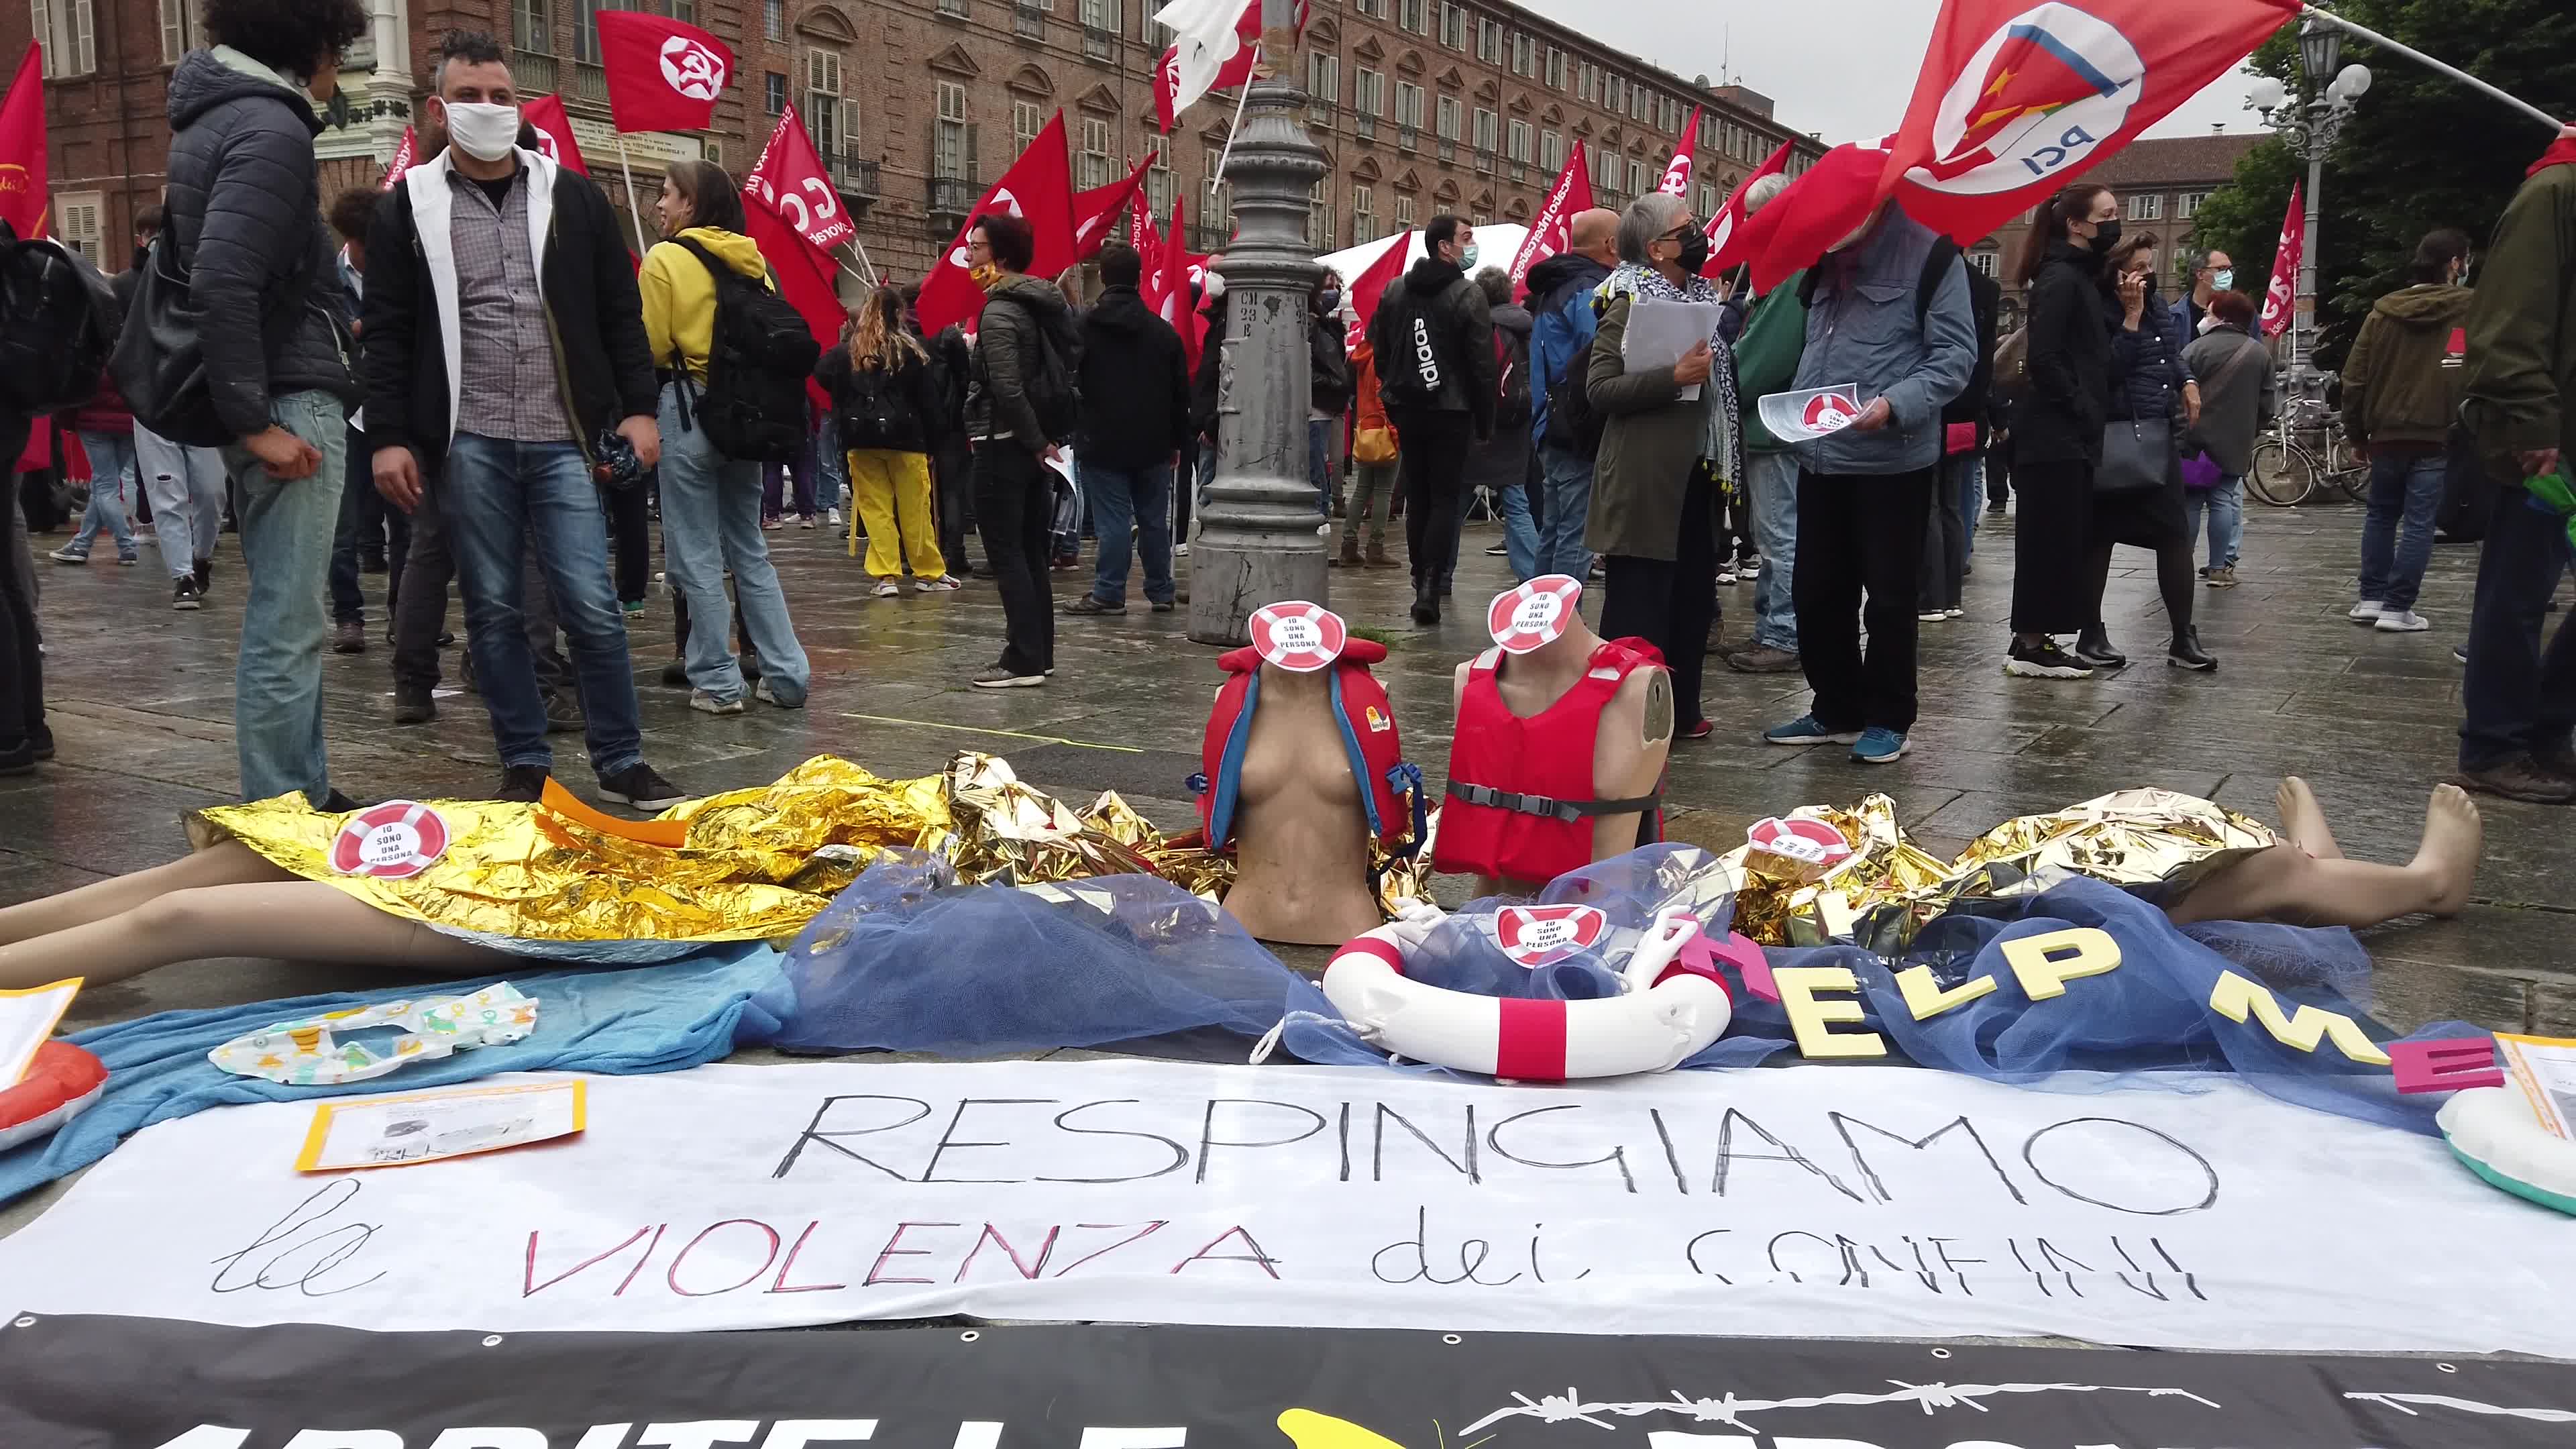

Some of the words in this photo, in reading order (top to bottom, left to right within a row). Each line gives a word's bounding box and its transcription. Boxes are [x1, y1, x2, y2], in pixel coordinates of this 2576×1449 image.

[1240, 307, 1256, 322] 23
[383, 825, 392, 833] IO
[376, 833, 402, 845] SONO
[381, 844, 400, 854] UNA
[1537, 926, 1562, 934] SONO
[1526, 937, 1568, 948] PERSONA
[2210, 970, 2506, 1095] ME
[771, 1095, 2220, 1216] RESPINGIAMO
[523, 1219, 1283, 1297] VIOLENZA
[1372, 1205, 1592, 1285] dei
